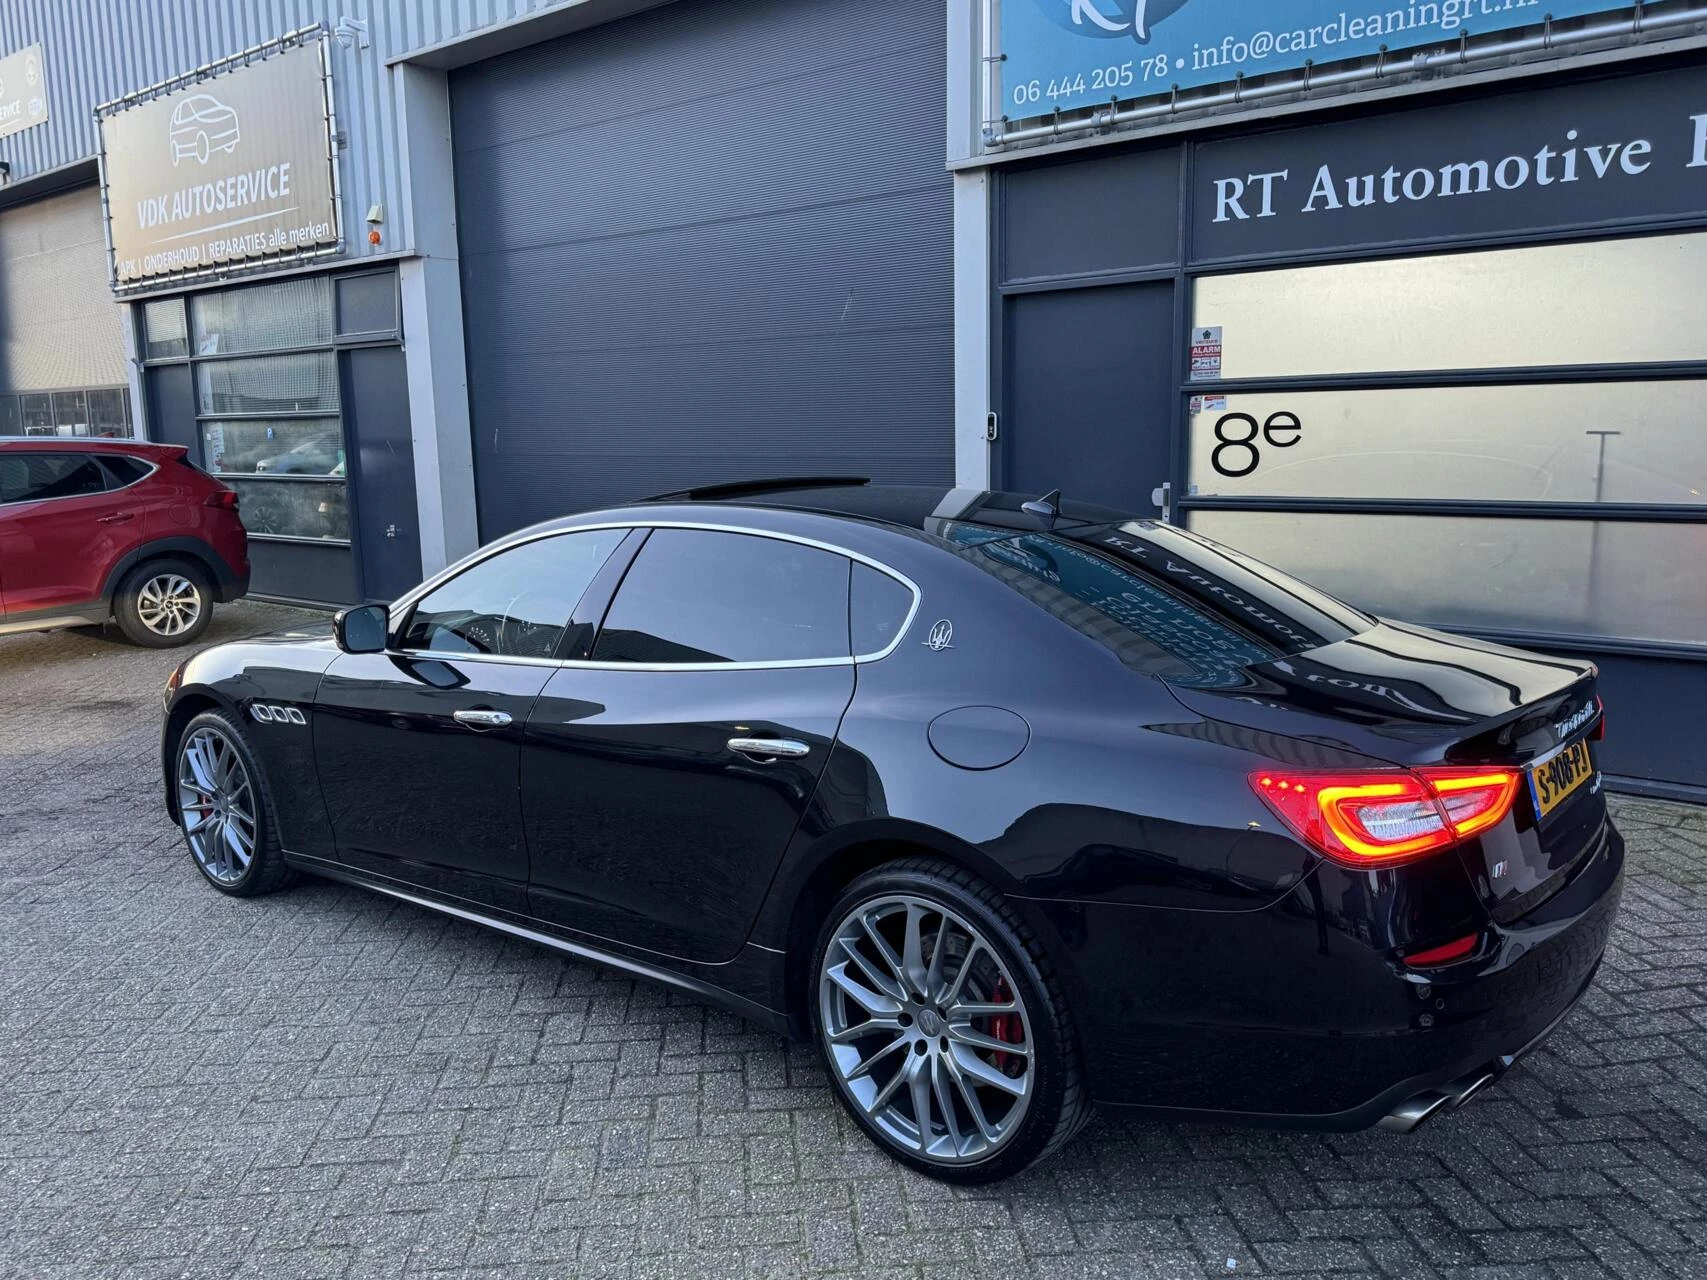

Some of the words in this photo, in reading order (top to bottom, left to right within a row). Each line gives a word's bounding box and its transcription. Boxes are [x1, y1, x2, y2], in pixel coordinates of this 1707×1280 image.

[1013, 79, 1040, 105] 06
[1046, 73, 1086, 100] 444
[1091, 61, 1134, 90] 205
[1140, 54, 1168, 81] 78
[136, 194, 170, 229] VDK
[171, 162, 291, 222] AUTOSERVICE
[1212, 168, 1288, 222] RT
[1301, 129, 1652, 213] Automotive
[120, 258, 136, 275] APK
[143, 246, 200, 271] ONDERHOUD
[208, 232, 266, 259] REPARATIES
[268, 227, 287, 247] alle
[289, 220, 330, 243] merken
[1192, 346, 1221, 354] ALARM
